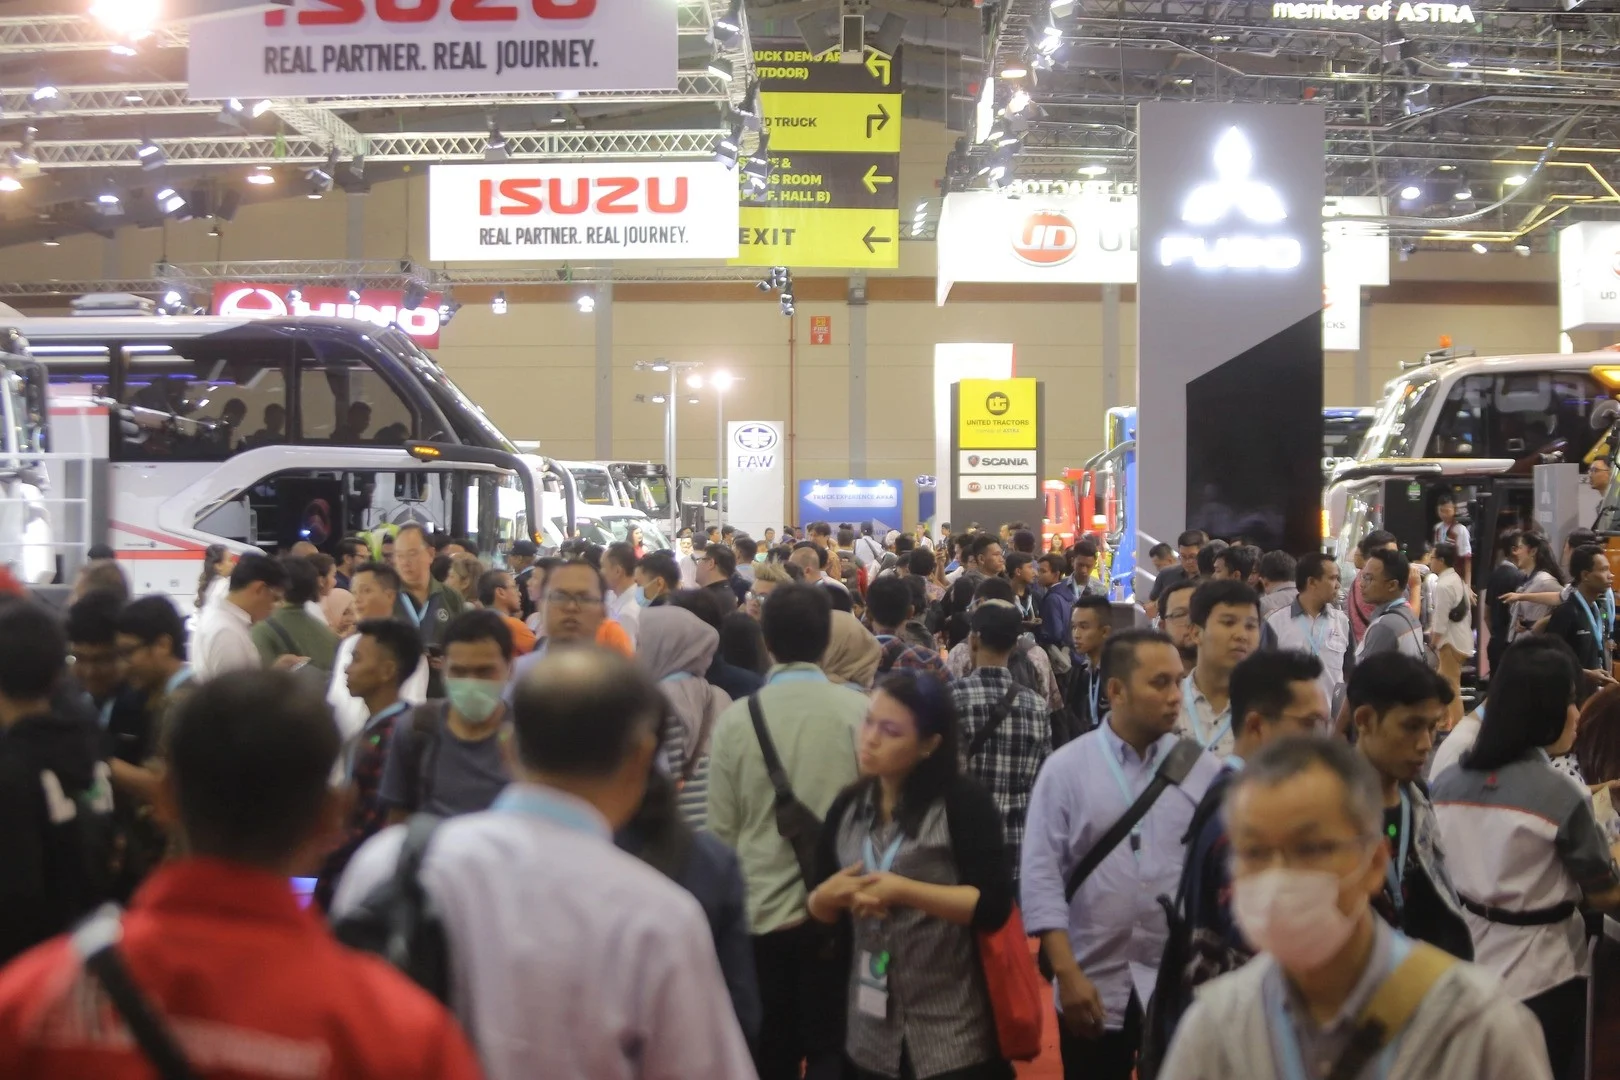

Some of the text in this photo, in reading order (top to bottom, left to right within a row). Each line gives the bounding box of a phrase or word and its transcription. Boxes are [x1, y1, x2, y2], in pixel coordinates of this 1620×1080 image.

[1273, 0, 1475, 23] member of ASTRA
[264, 38, 599, 74] REAL PARTNER. REAL JOURNEY.
[754, 51, 782, 62] UCK
[775, 117, 817, 127] TRUCK
[782, 174, 822, 185] ROOM
[479, 176, 689, 216] ISUZU
[781, 191, 814, 202] HALL
[816, 191, 831, 203] B)
[479, 226, 689, 247] REAL PARTNER. REAL JOURNEY.
[739, 227, 796, 246] EXIT
[737, 455, 774, 468] FAW
[982, 457, 1029, 466] SCANIA
[998, 483, 1030, 491] TRUCKS
